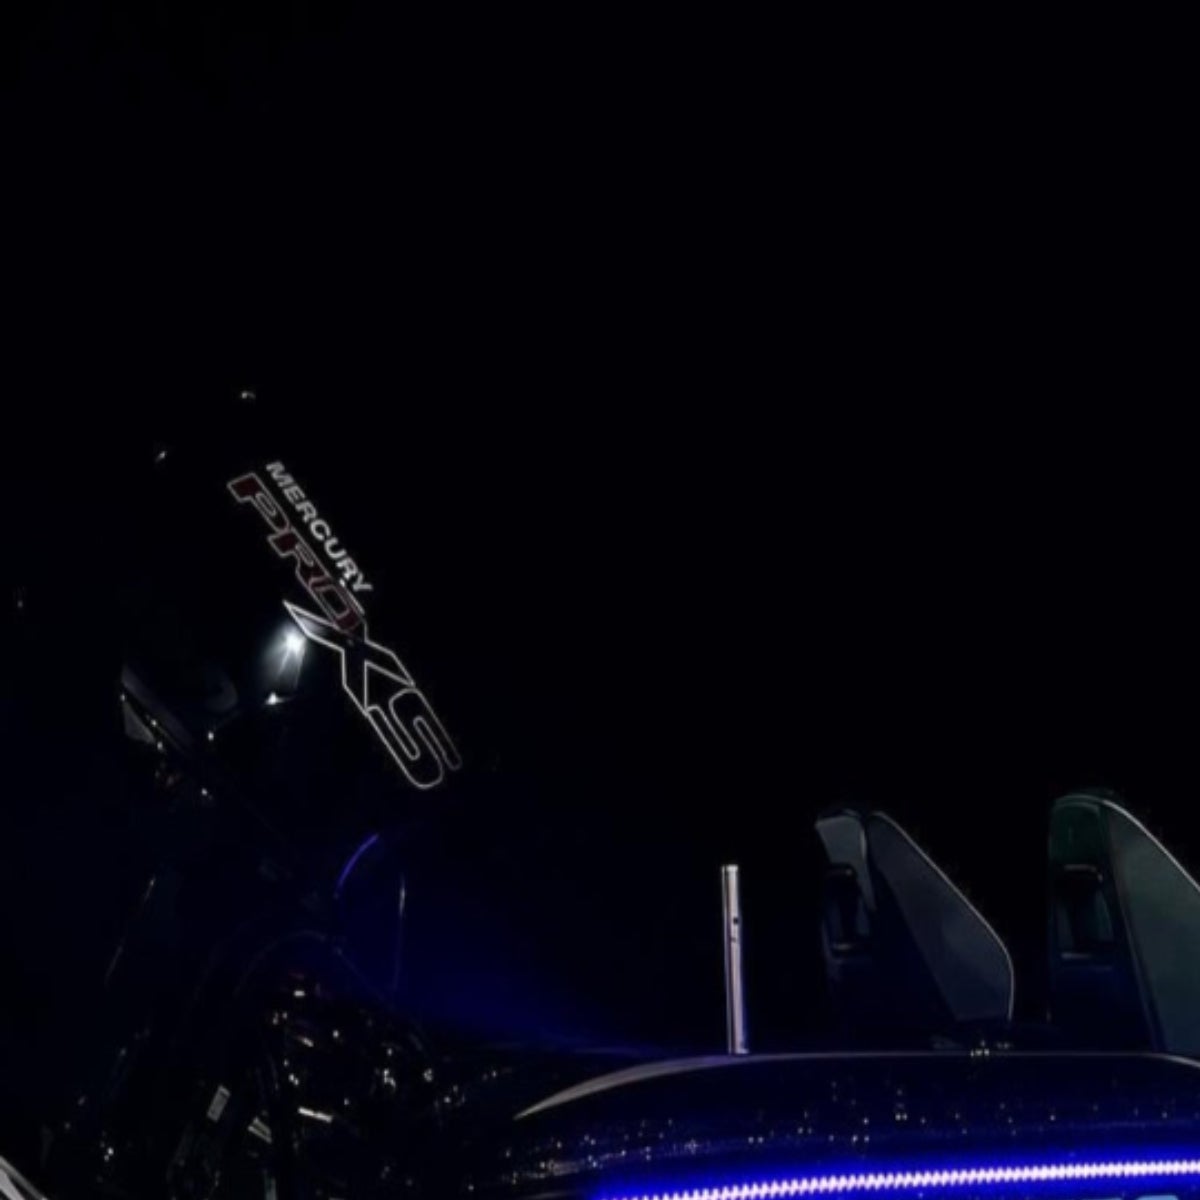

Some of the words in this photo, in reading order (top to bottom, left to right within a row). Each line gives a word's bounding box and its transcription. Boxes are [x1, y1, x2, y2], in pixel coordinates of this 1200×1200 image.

[227, 471, 367, 635] PRO
[265, 460, 374, 594] MERCURY
[283, 599, 463, 790] XS
